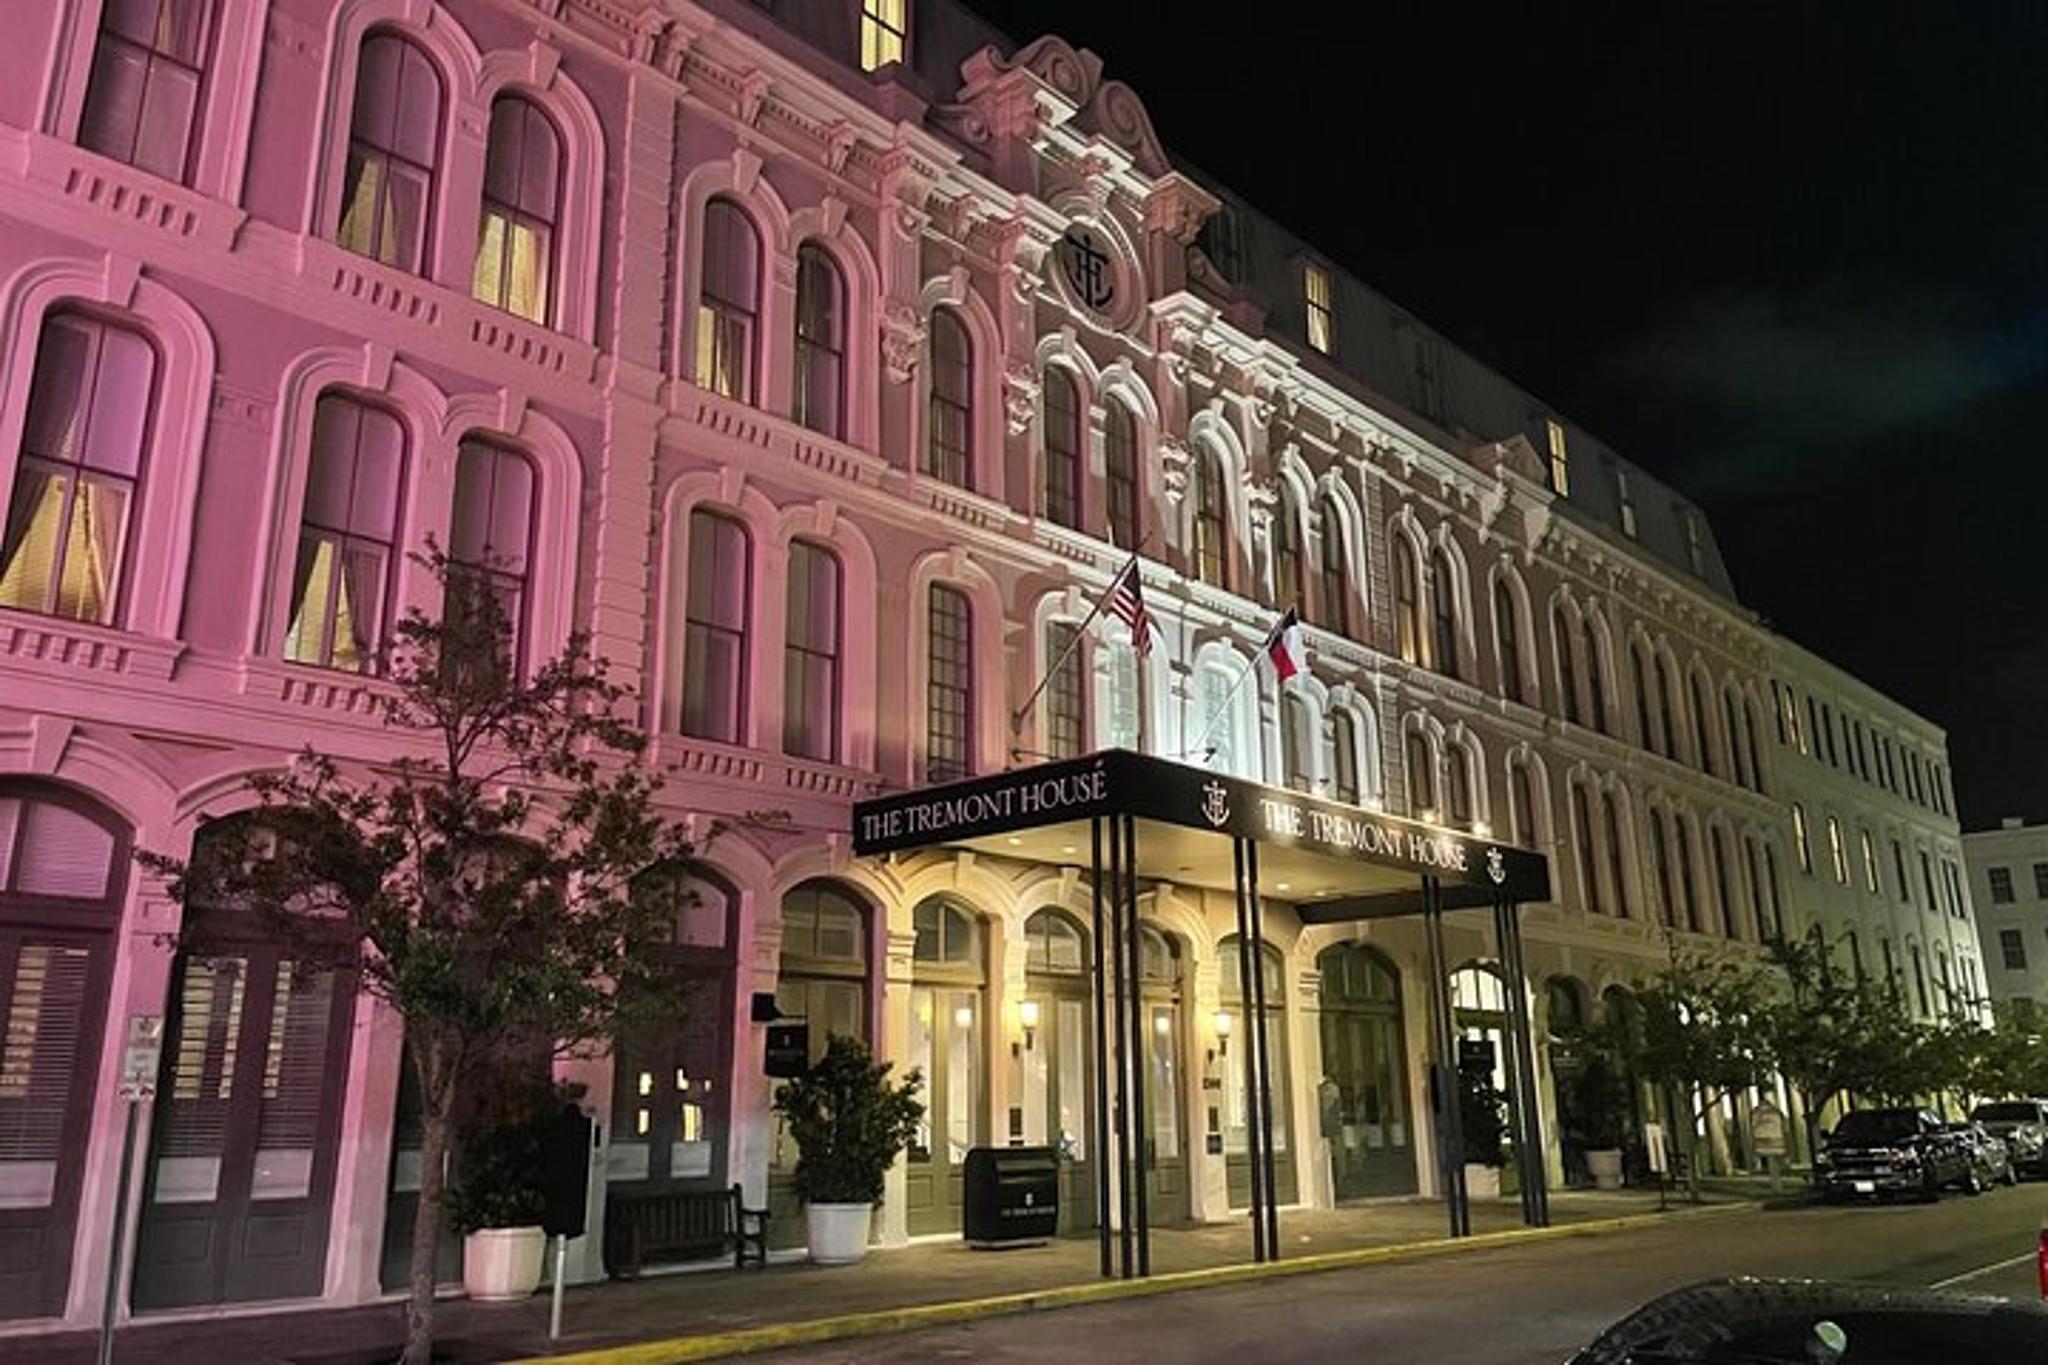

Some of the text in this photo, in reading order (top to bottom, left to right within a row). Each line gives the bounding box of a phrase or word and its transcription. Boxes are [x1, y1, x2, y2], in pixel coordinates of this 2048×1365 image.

[862, 771, 1107, 840] THE TREMONT HOUSE
[1260, 799, 1469, 872] THE TREMONT HOUSE
